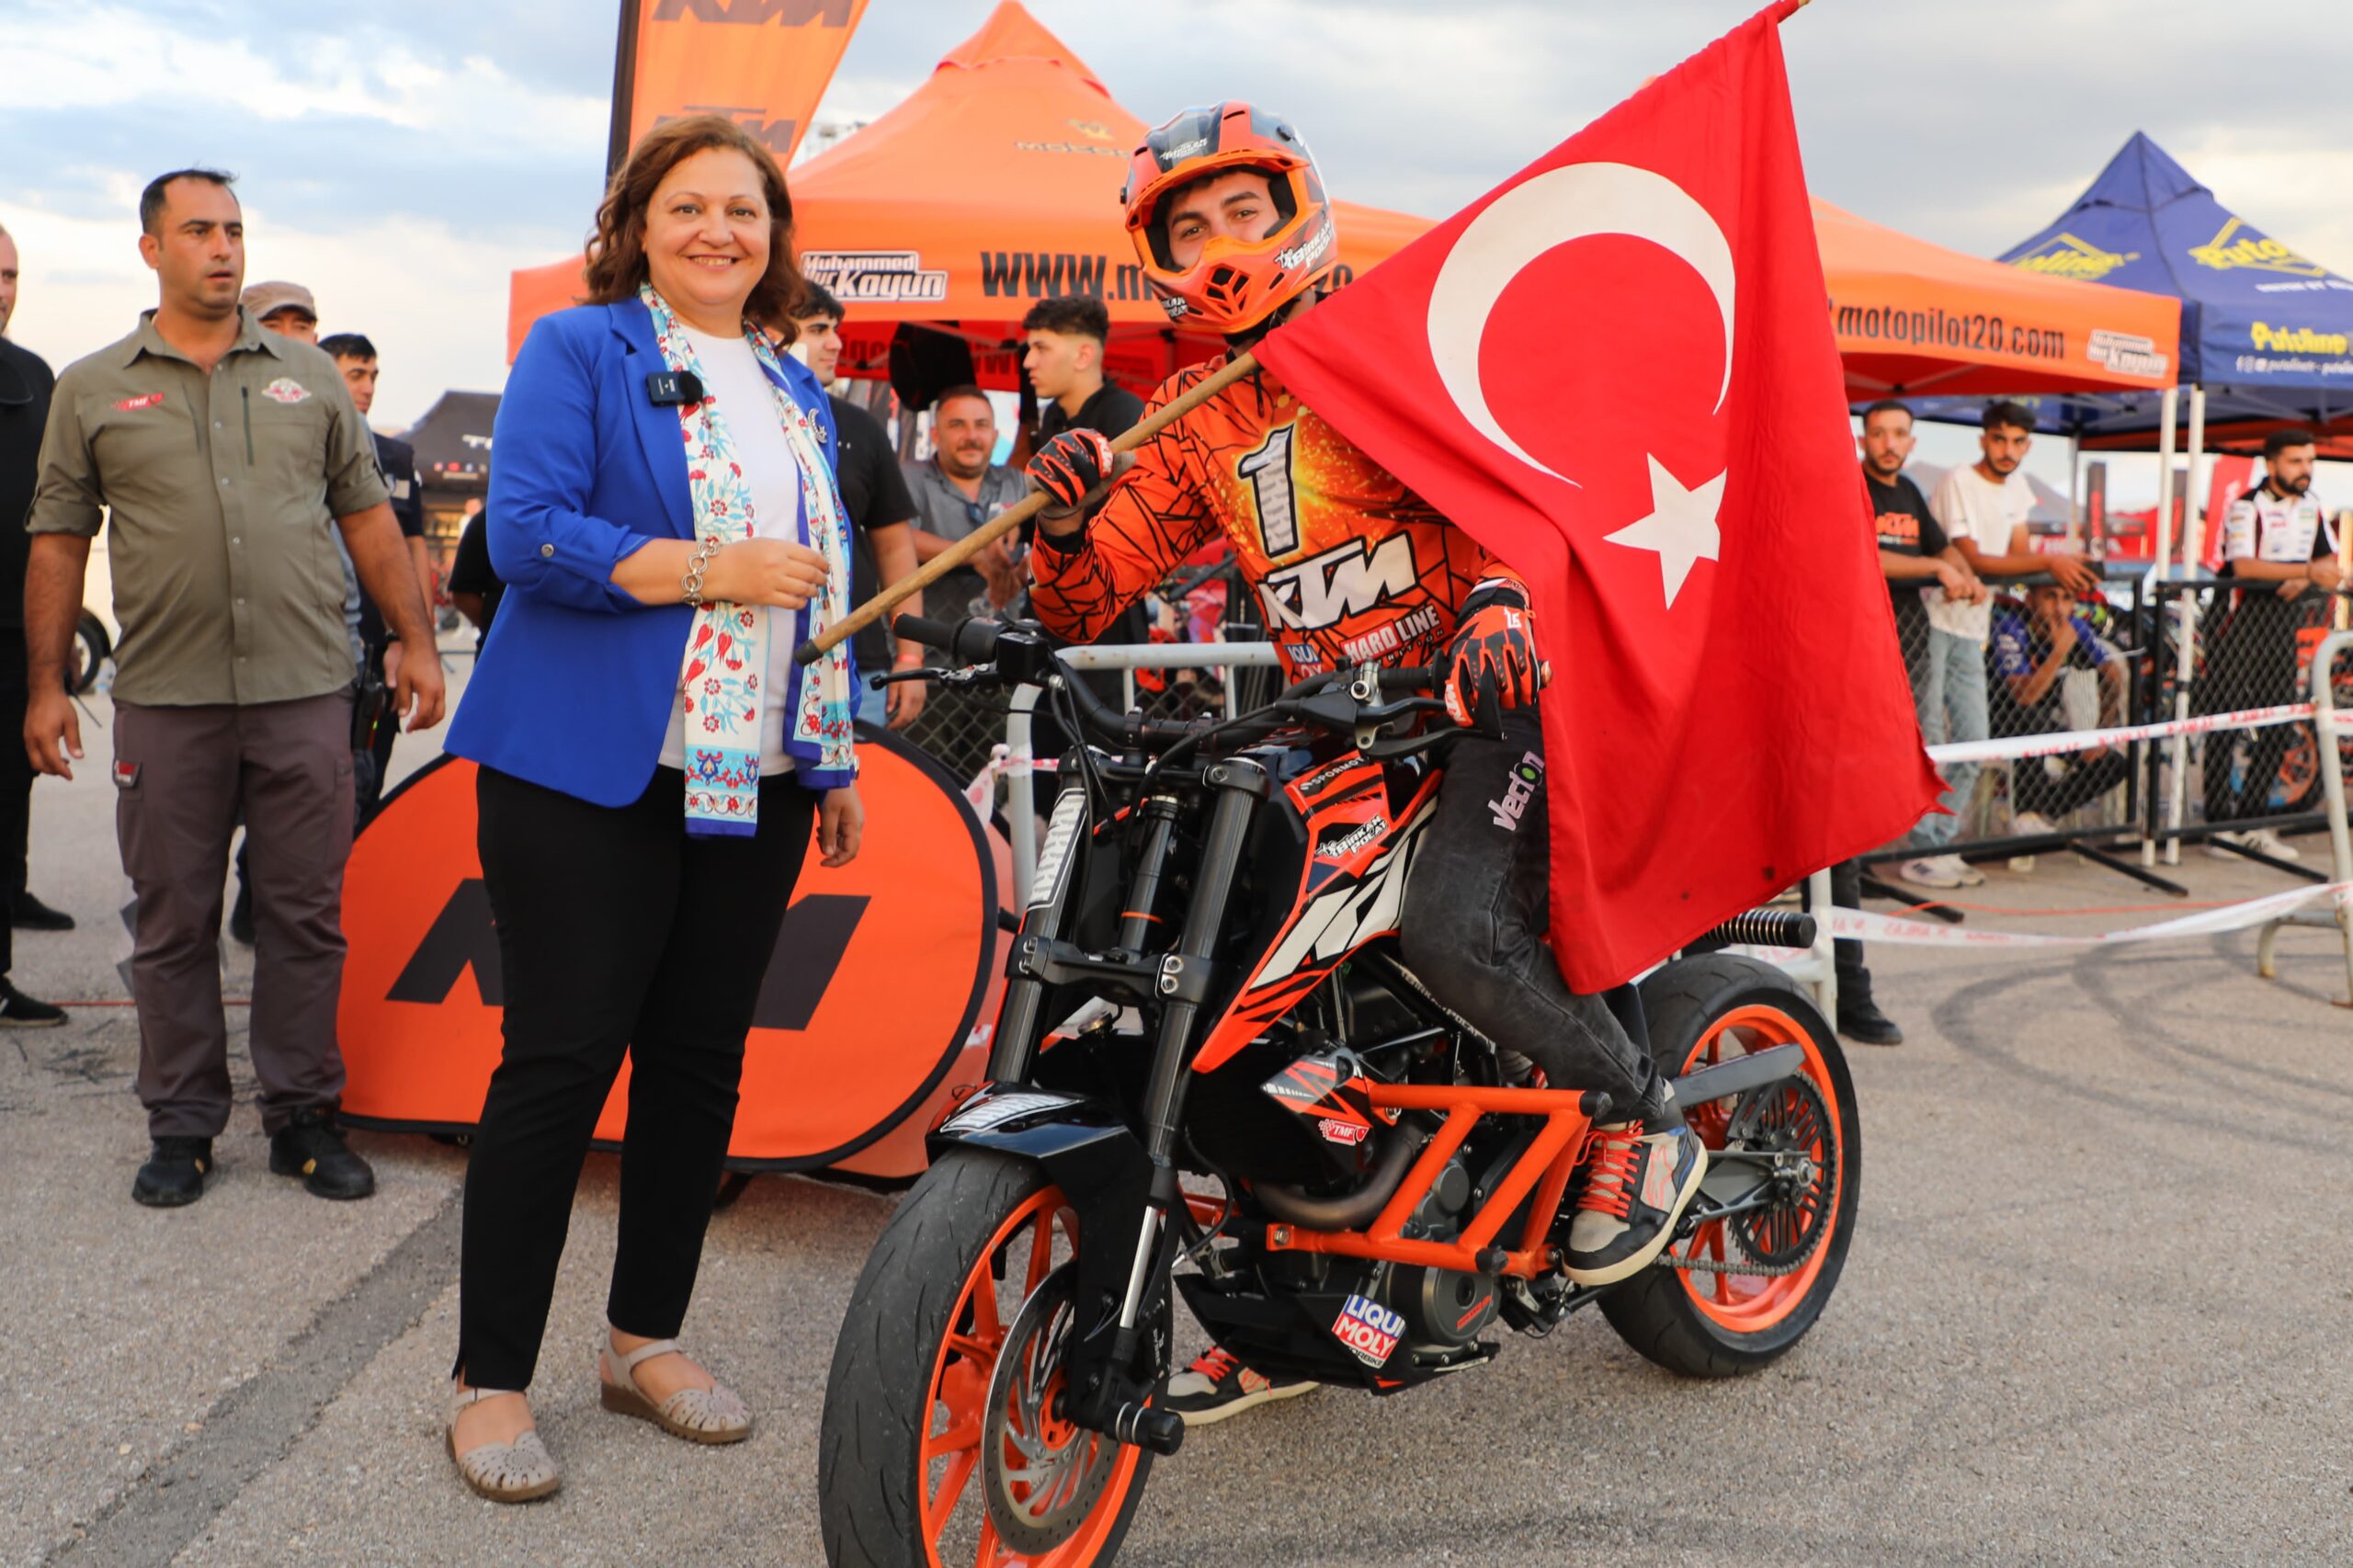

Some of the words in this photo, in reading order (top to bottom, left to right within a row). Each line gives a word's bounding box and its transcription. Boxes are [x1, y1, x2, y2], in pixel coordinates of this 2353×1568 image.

[835, 270, 942, 301] Kayun
[1837, 306, 2065, 359] motopilot20.com
[1238, 423, 1300, 558] 1
[1256, 530, 1420, 631] KTM
[1343, 624, 1399, 664] HARD
[1395, 604, 1440, 642] LINE
[1350, 820, 1387, 854] POLAT
[1333, 1125, 1354, 1138] TMF
[1347, 1294, 1406, 1337] LIQUI
[1336, 1316, 1397, 1360] MOLY
